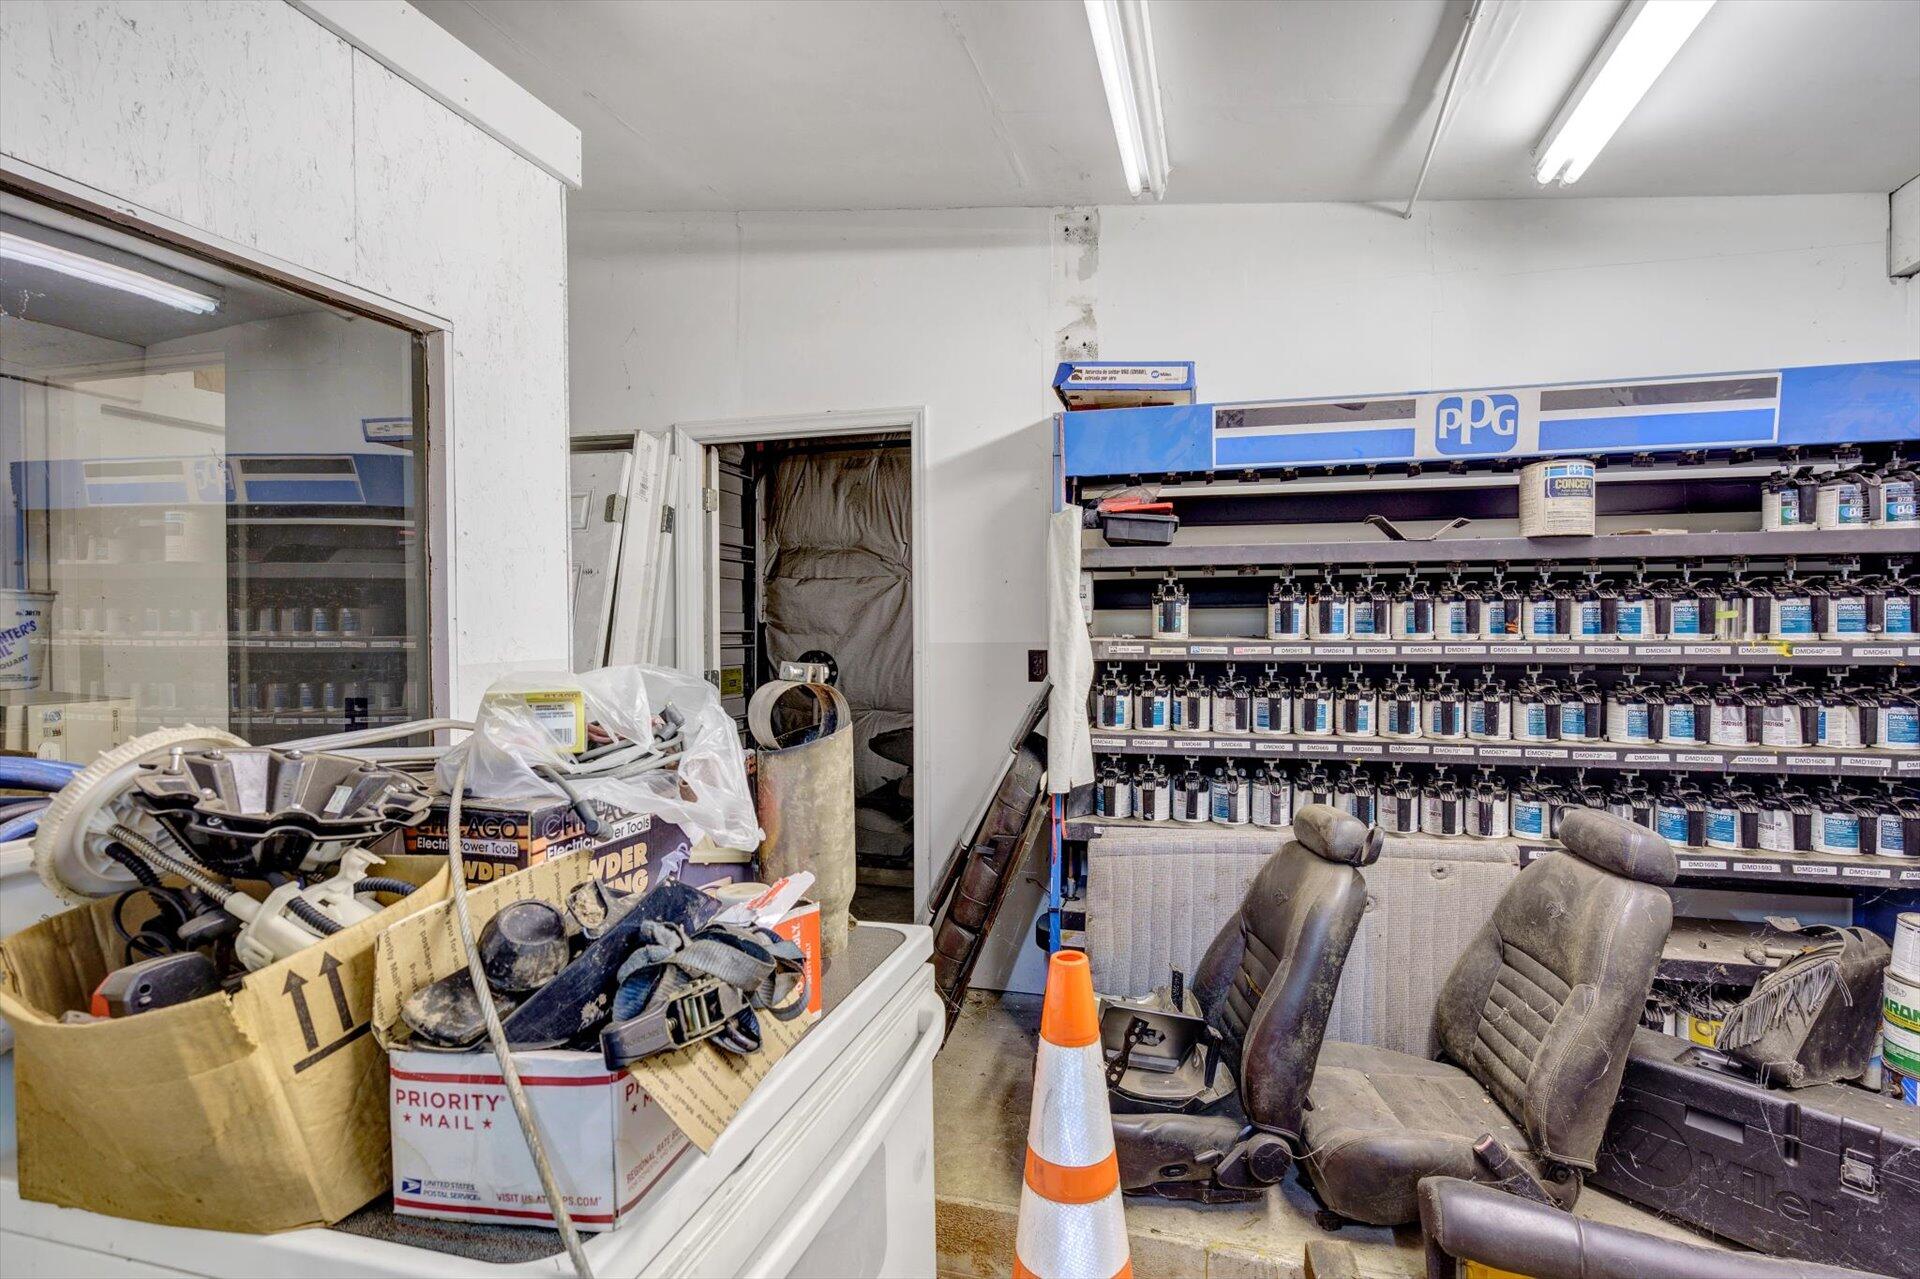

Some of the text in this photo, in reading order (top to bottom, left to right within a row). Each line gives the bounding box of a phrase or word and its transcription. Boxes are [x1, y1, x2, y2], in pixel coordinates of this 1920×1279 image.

[1439, 396, 1516, 445] PPG
[626, 818, 651, 834] Tools
[417, 836, 450, 851] Electri
[491, 842, 518, 855] Tools
[395, 1088, 500, 1112] PRIORITY
[419, 1113, 475, 1131] MAIL
[423, 1179, 476, 1191] UNITED STATES
[423, 1190, 448, 1199] POSTAL
[496, 1193, 519, 1203] VISIT
[521, 1194, 533, 1203] US
[536, 1194, 547, 1205] AT
